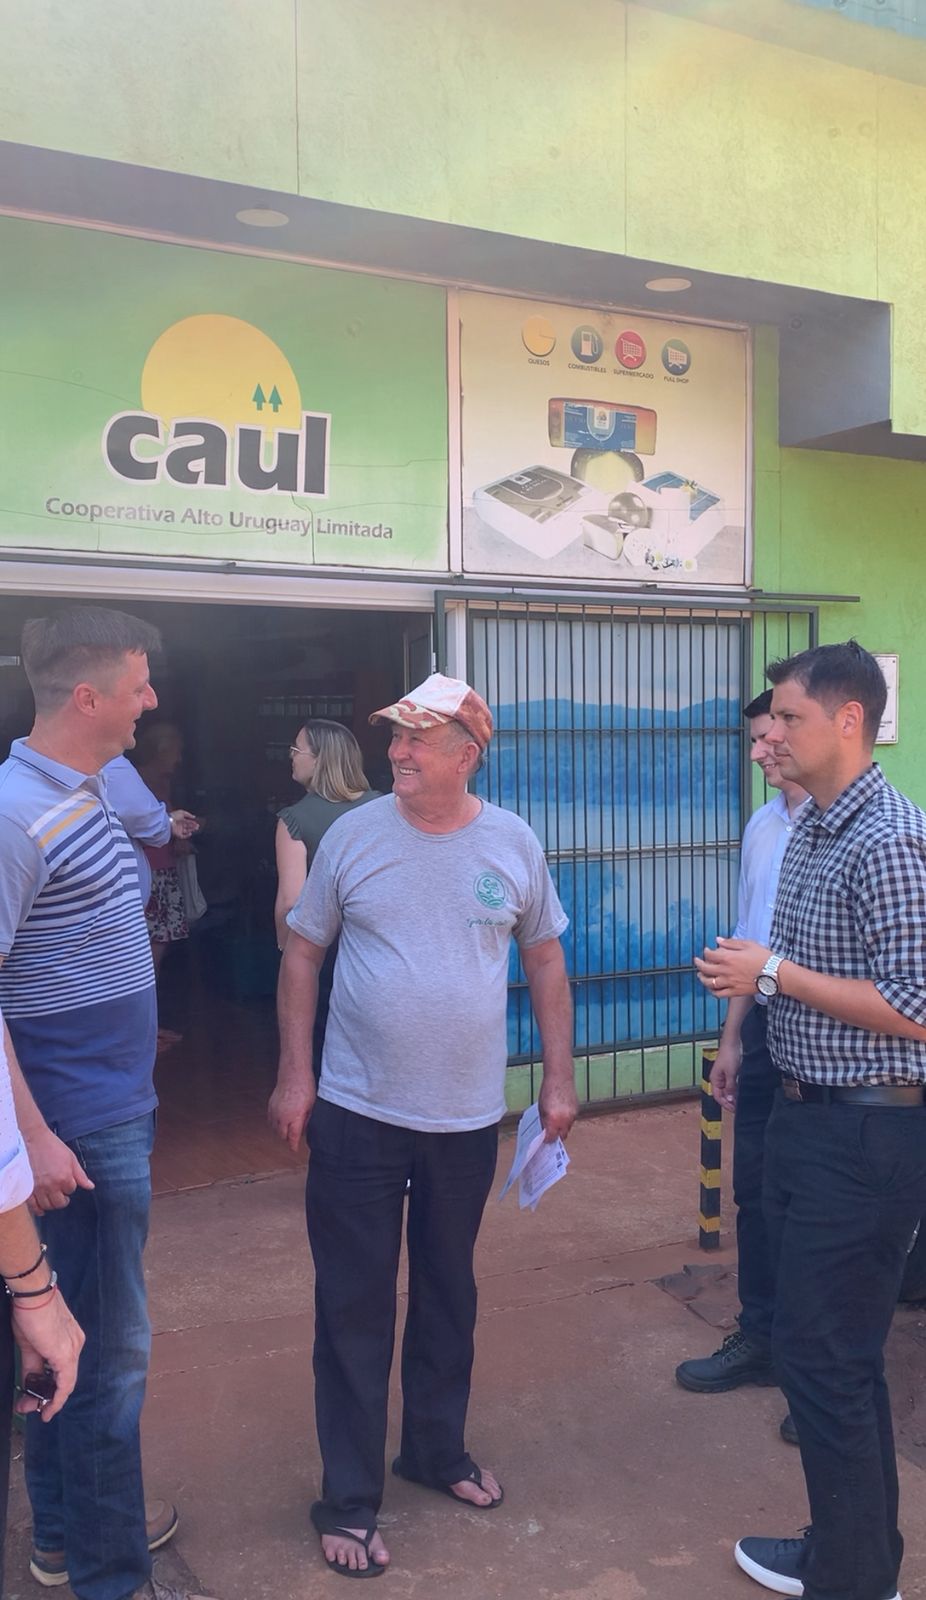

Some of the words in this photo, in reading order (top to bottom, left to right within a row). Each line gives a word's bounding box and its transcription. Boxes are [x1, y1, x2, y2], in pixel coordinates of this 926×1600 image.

[528, 358, 550, 366] QUESOS
[568, 363, 607, 373] COMBUSTIBLES
[613, 369, 654, 379] SUPERMERCADO
[104, 412, 330, 497] caul
[46, 497, 175, 522] Cooperativa
[181, 507, 223, 526] Alto
[229, 511, 311, 536] Uruguay
[317, 518, 393, 539] Limitada
